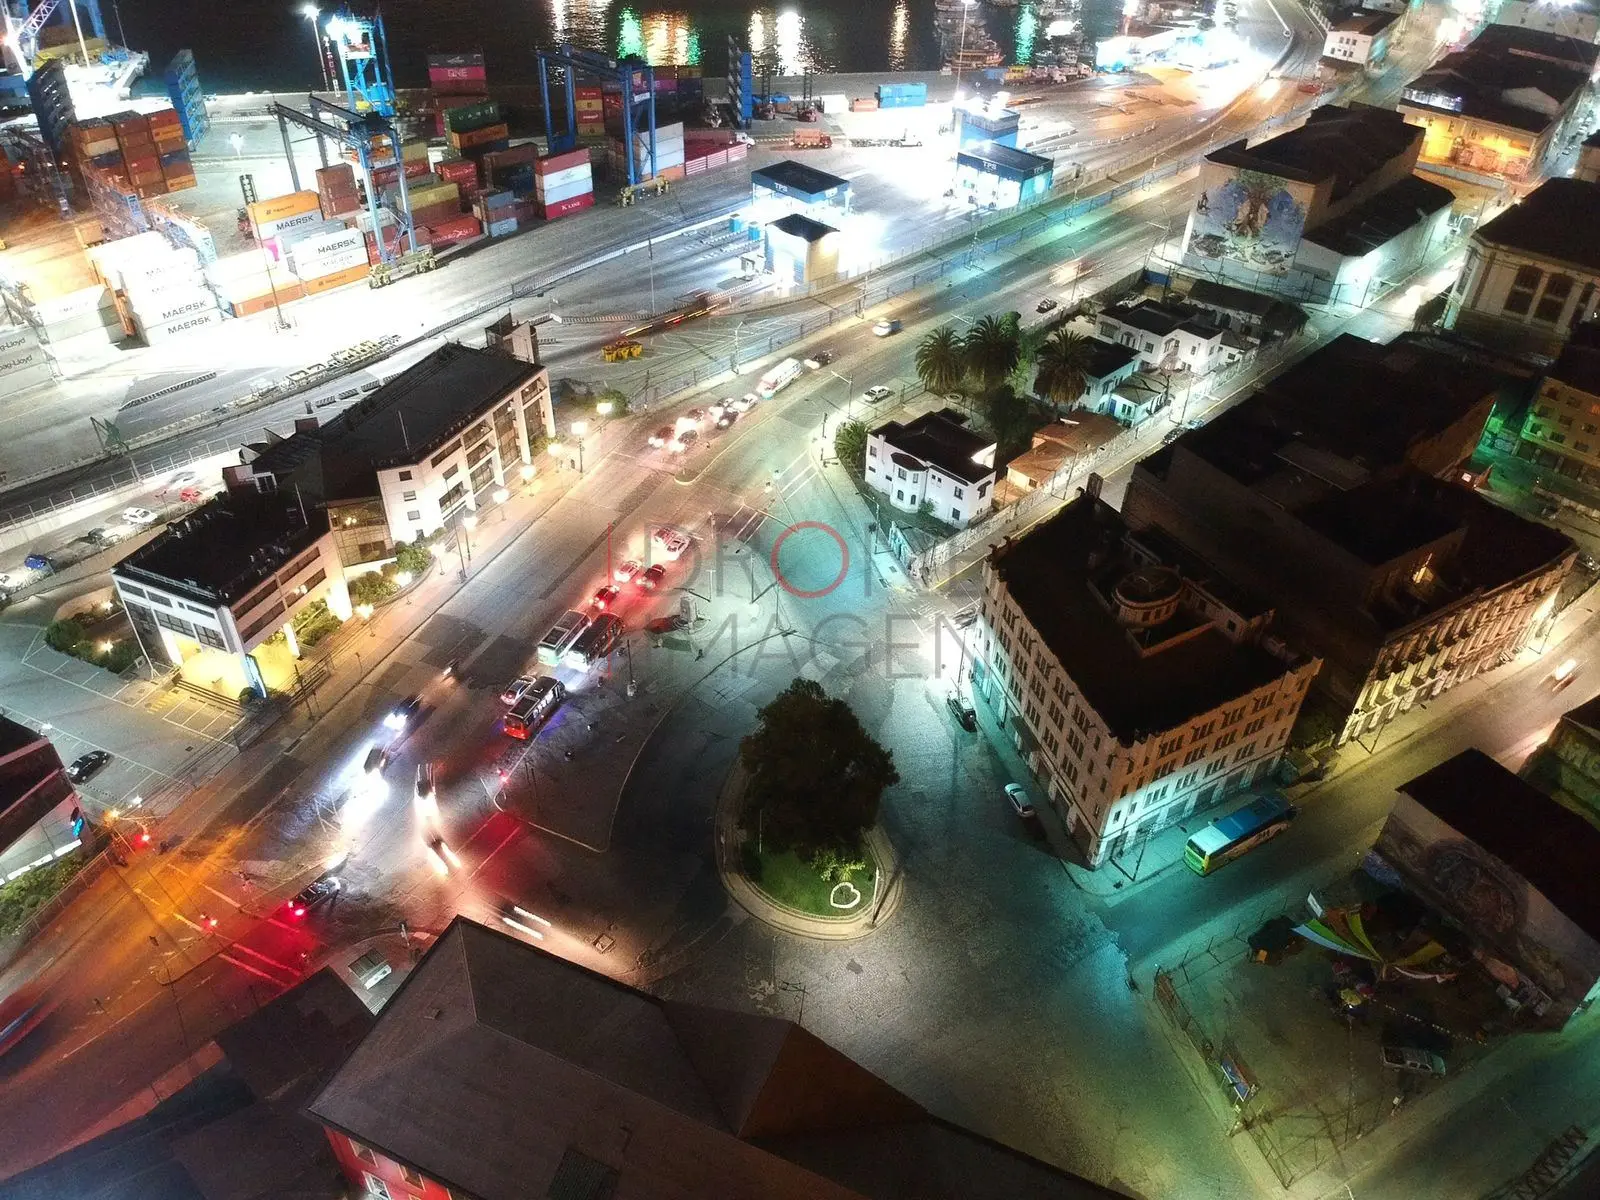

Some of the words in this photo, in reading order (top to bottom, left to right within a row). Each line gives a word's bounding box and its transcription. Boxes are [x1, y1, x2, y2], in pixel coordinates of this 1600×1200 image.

[982, 161, 997, 170] TPS
[774, 182, 788, 193] TPS
[276, 214, 315, 232] MAERSK
[317, 237, 357, 255] MAERSK
[162, 300, 208, 320] MAERSK
[167, 315, 212, 335] MAERSK
